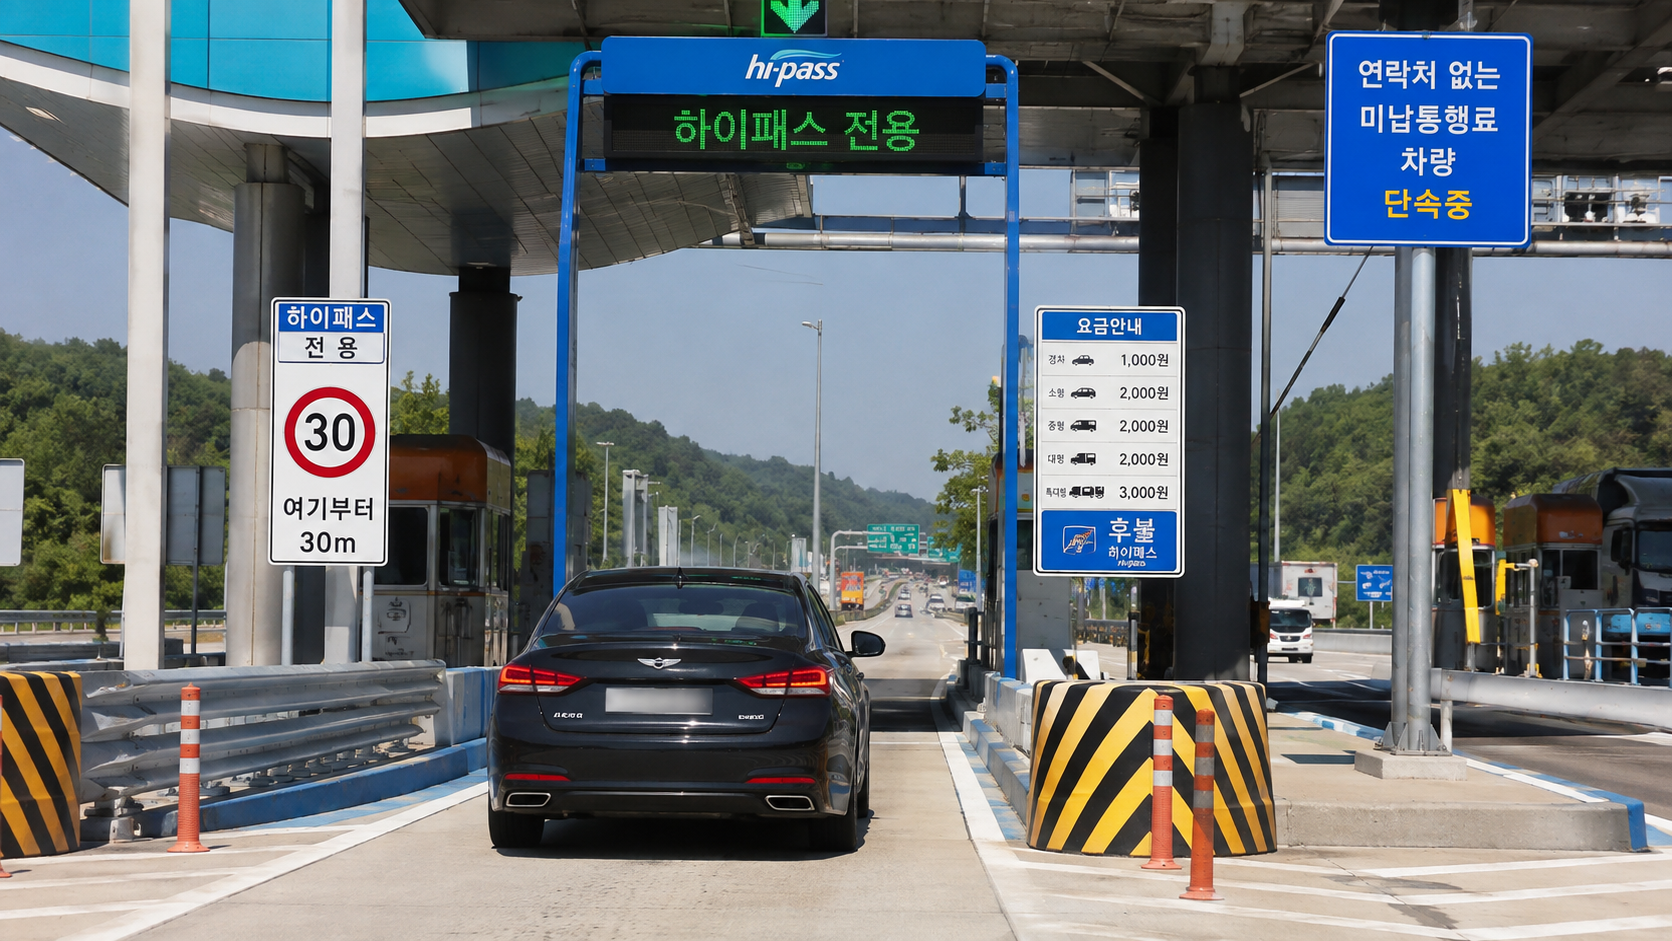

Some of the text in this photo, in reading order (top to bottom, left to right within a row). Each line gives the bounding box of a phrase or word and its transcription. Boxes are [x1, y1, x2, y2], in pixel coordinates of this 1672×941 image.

[745, 53, 840, 87] hi-pass
[1358, 59, 1501, 90] 연락처 없는
[674, 108, 920, 152] 하이패스 전용
[1360, 104, 1498, 135] 미납통행료
[1400, 147, 1456, 177] 차량
[1384, 188, 1473, 220] 단속중
[286, 305, 376, 330] 하이패스
[1076, 317, 1142, 336] 요금안내
[1121, 353, 1169, 367] 1,000원
[1119, 386, 1169, 400] 2,000원
[304, 412, 356, 452] 30
[1119, 419, 1169, 434] 2,000원
[1119, 452, 1169, 467] 2,000원
[1119, 485, 1169, 500] 3,000원
[283, 496, 373, 521] 여기부터
[299, 531, 356, 553] 30m
